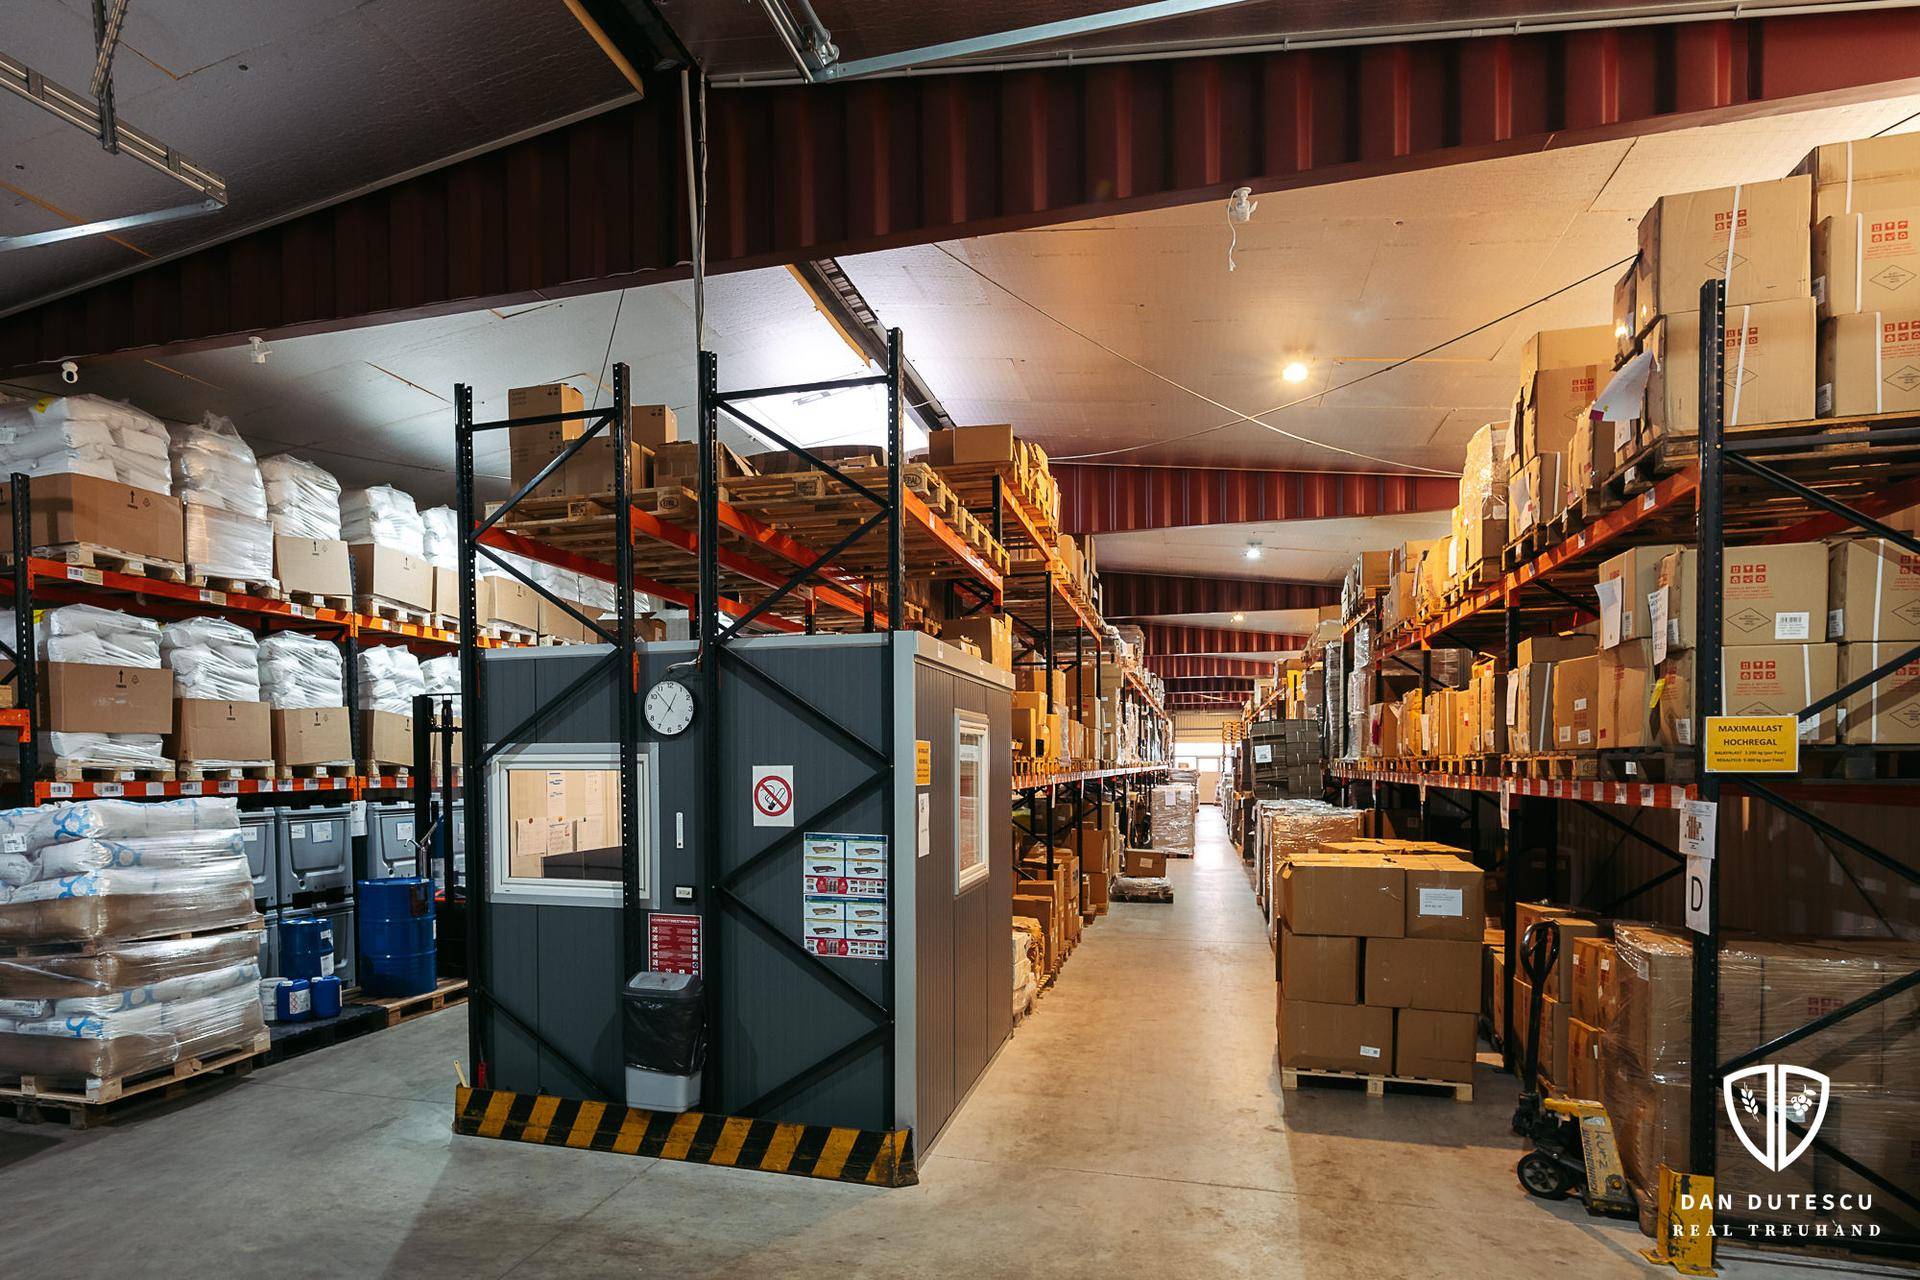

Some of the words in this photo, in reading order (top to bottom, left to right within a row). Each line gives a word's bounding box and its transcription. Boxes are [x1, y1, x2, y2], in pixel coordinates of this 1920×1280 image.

[1718, 725, 1783, 733] MAXIMALLAST
[1723, 738, 1778, 746] HOCHREGAL
[1690, 875, 1704, 912] D
